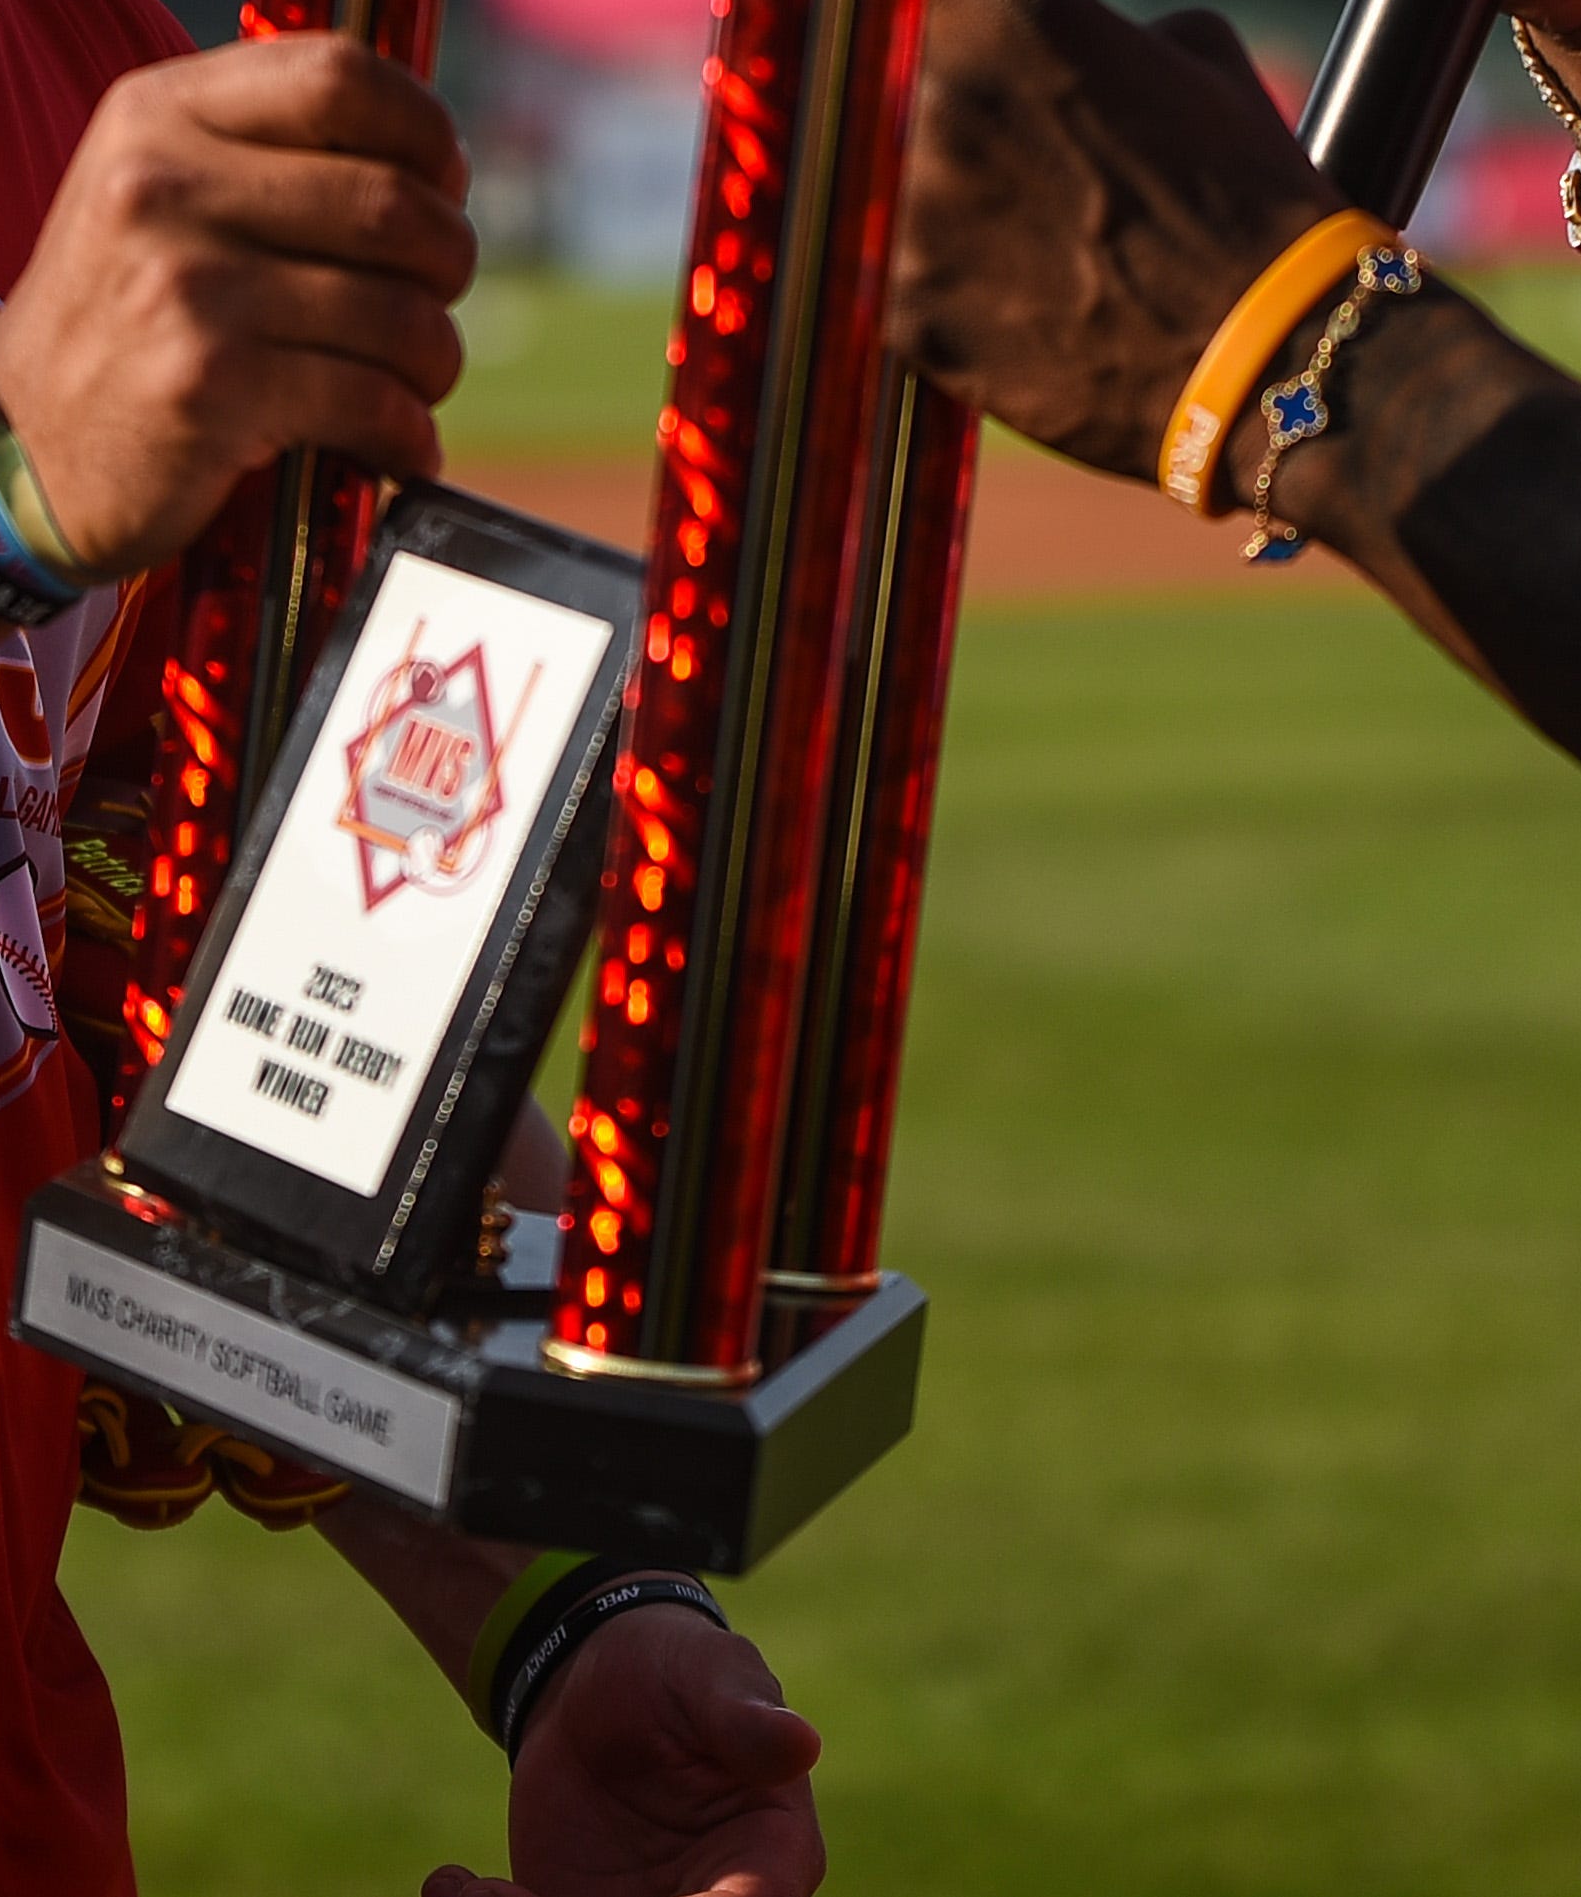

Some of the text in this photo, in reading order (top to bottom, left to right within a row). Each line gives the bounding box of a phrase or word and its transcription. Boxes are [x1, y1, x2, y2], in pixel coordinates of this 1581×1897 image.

[386, 713, 477, 802] MVS
[18, 785, 61, 838] GAM
[114, 1296, 208, 1362] CHARITY
[210, 1336, 321, 1416] SOFTBALL
[323, 1387, 394, 1447] GAME
[523, 1624, 568, 1683] LEGACY
